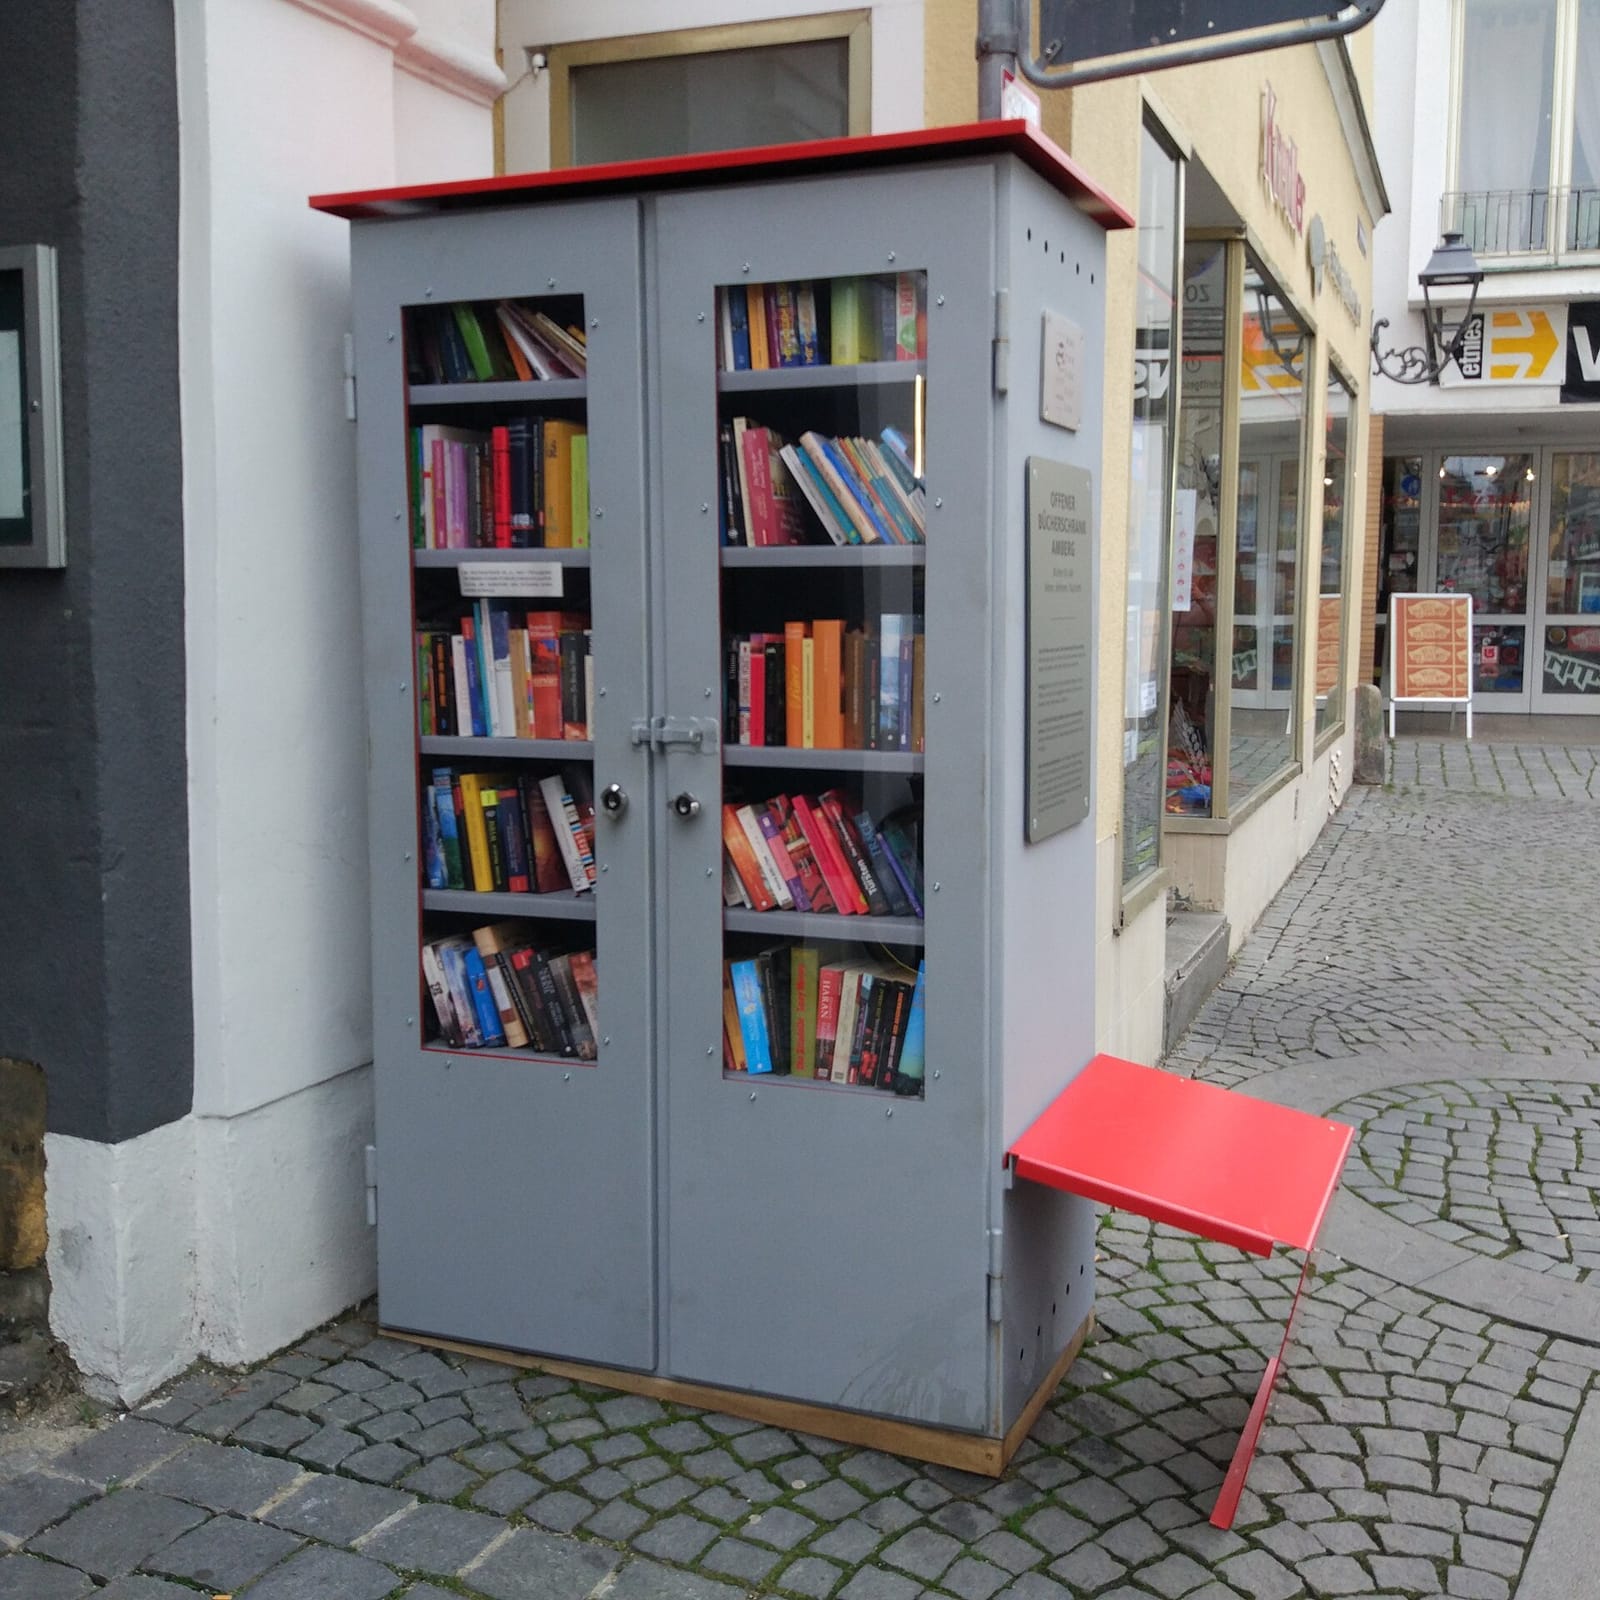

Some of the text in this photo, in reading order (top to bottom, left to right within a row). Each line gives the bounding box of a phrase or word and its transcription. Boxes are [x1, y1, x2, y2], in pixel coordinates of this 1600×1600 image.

[1461, 318, 1482, 376] etnies
[1050, 491, 1075, 511] OFFENER
[1051, 539, 1075, 557] AMBERG
